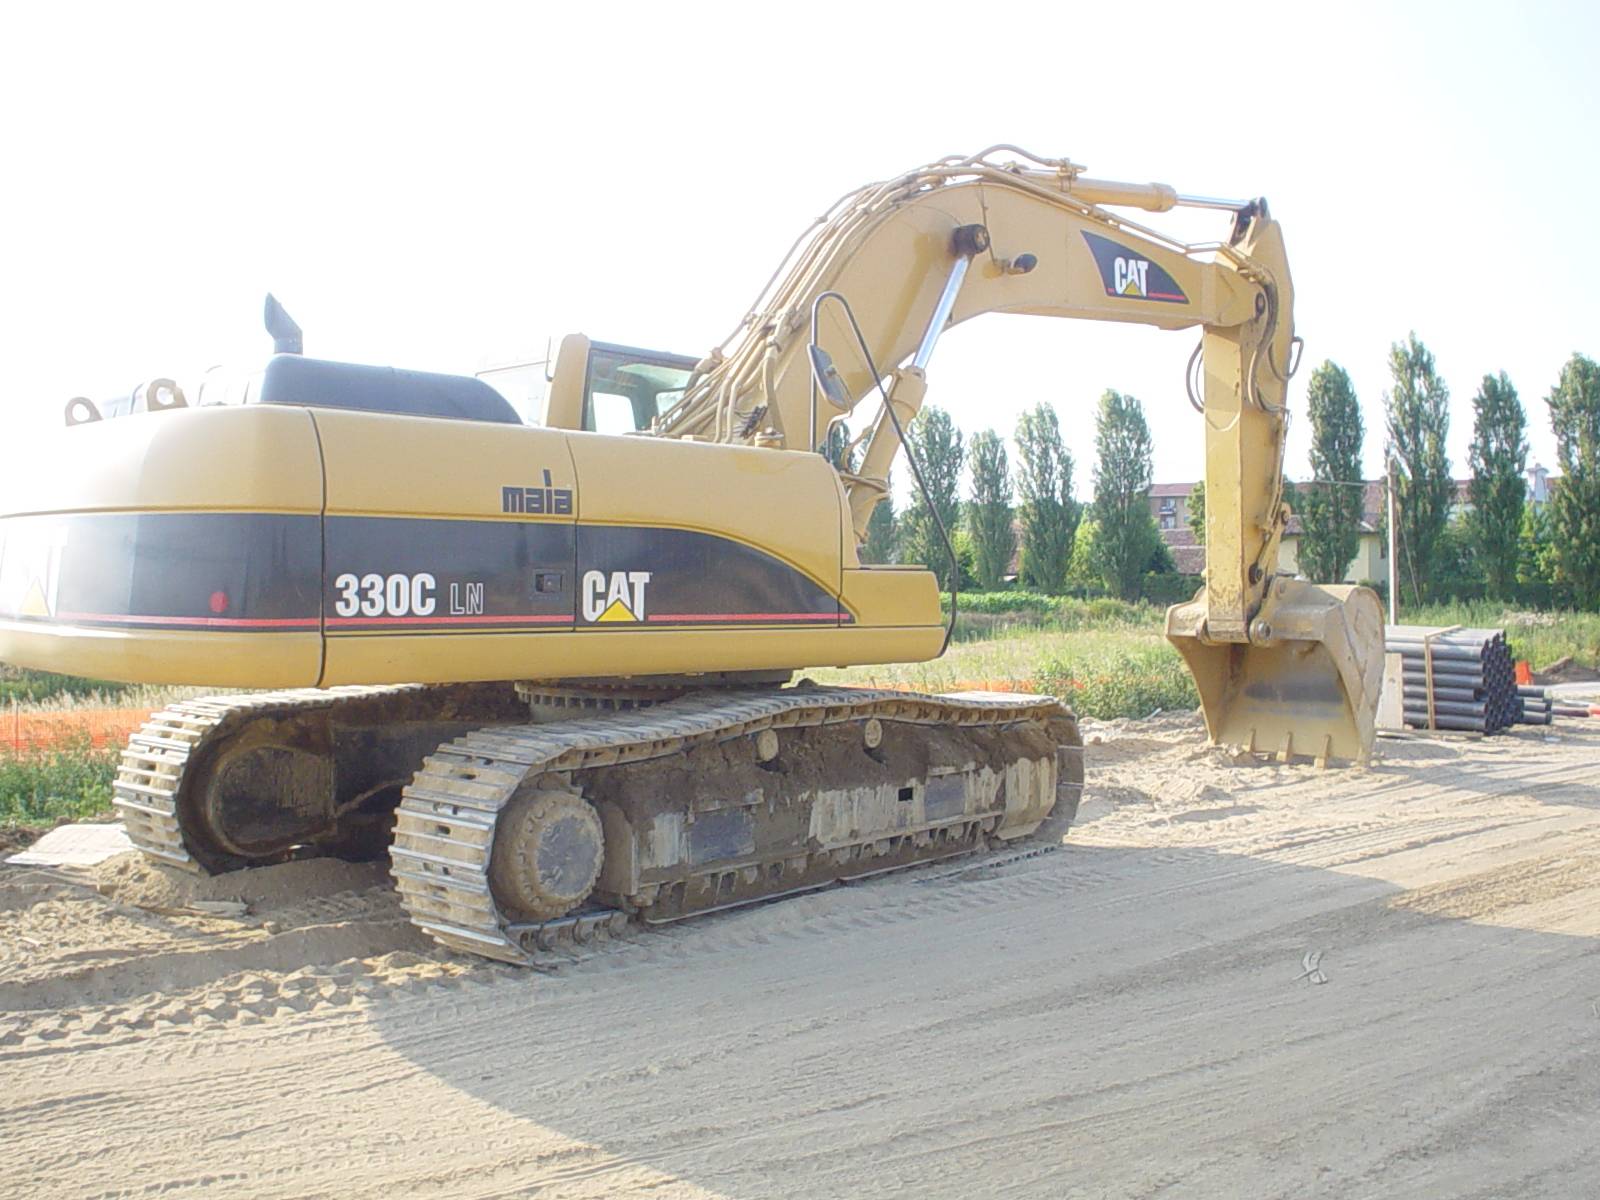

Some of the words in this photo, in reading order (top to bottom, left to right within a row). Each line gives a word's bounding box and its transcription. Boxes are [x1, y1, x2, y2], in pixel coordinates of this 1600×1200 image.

[1114, 257, 1149, 297] CAT
[335, 573, 436, 617] 330C
[450, 583, 484, 615] LN
[582, 570, 650, 622] CAT
